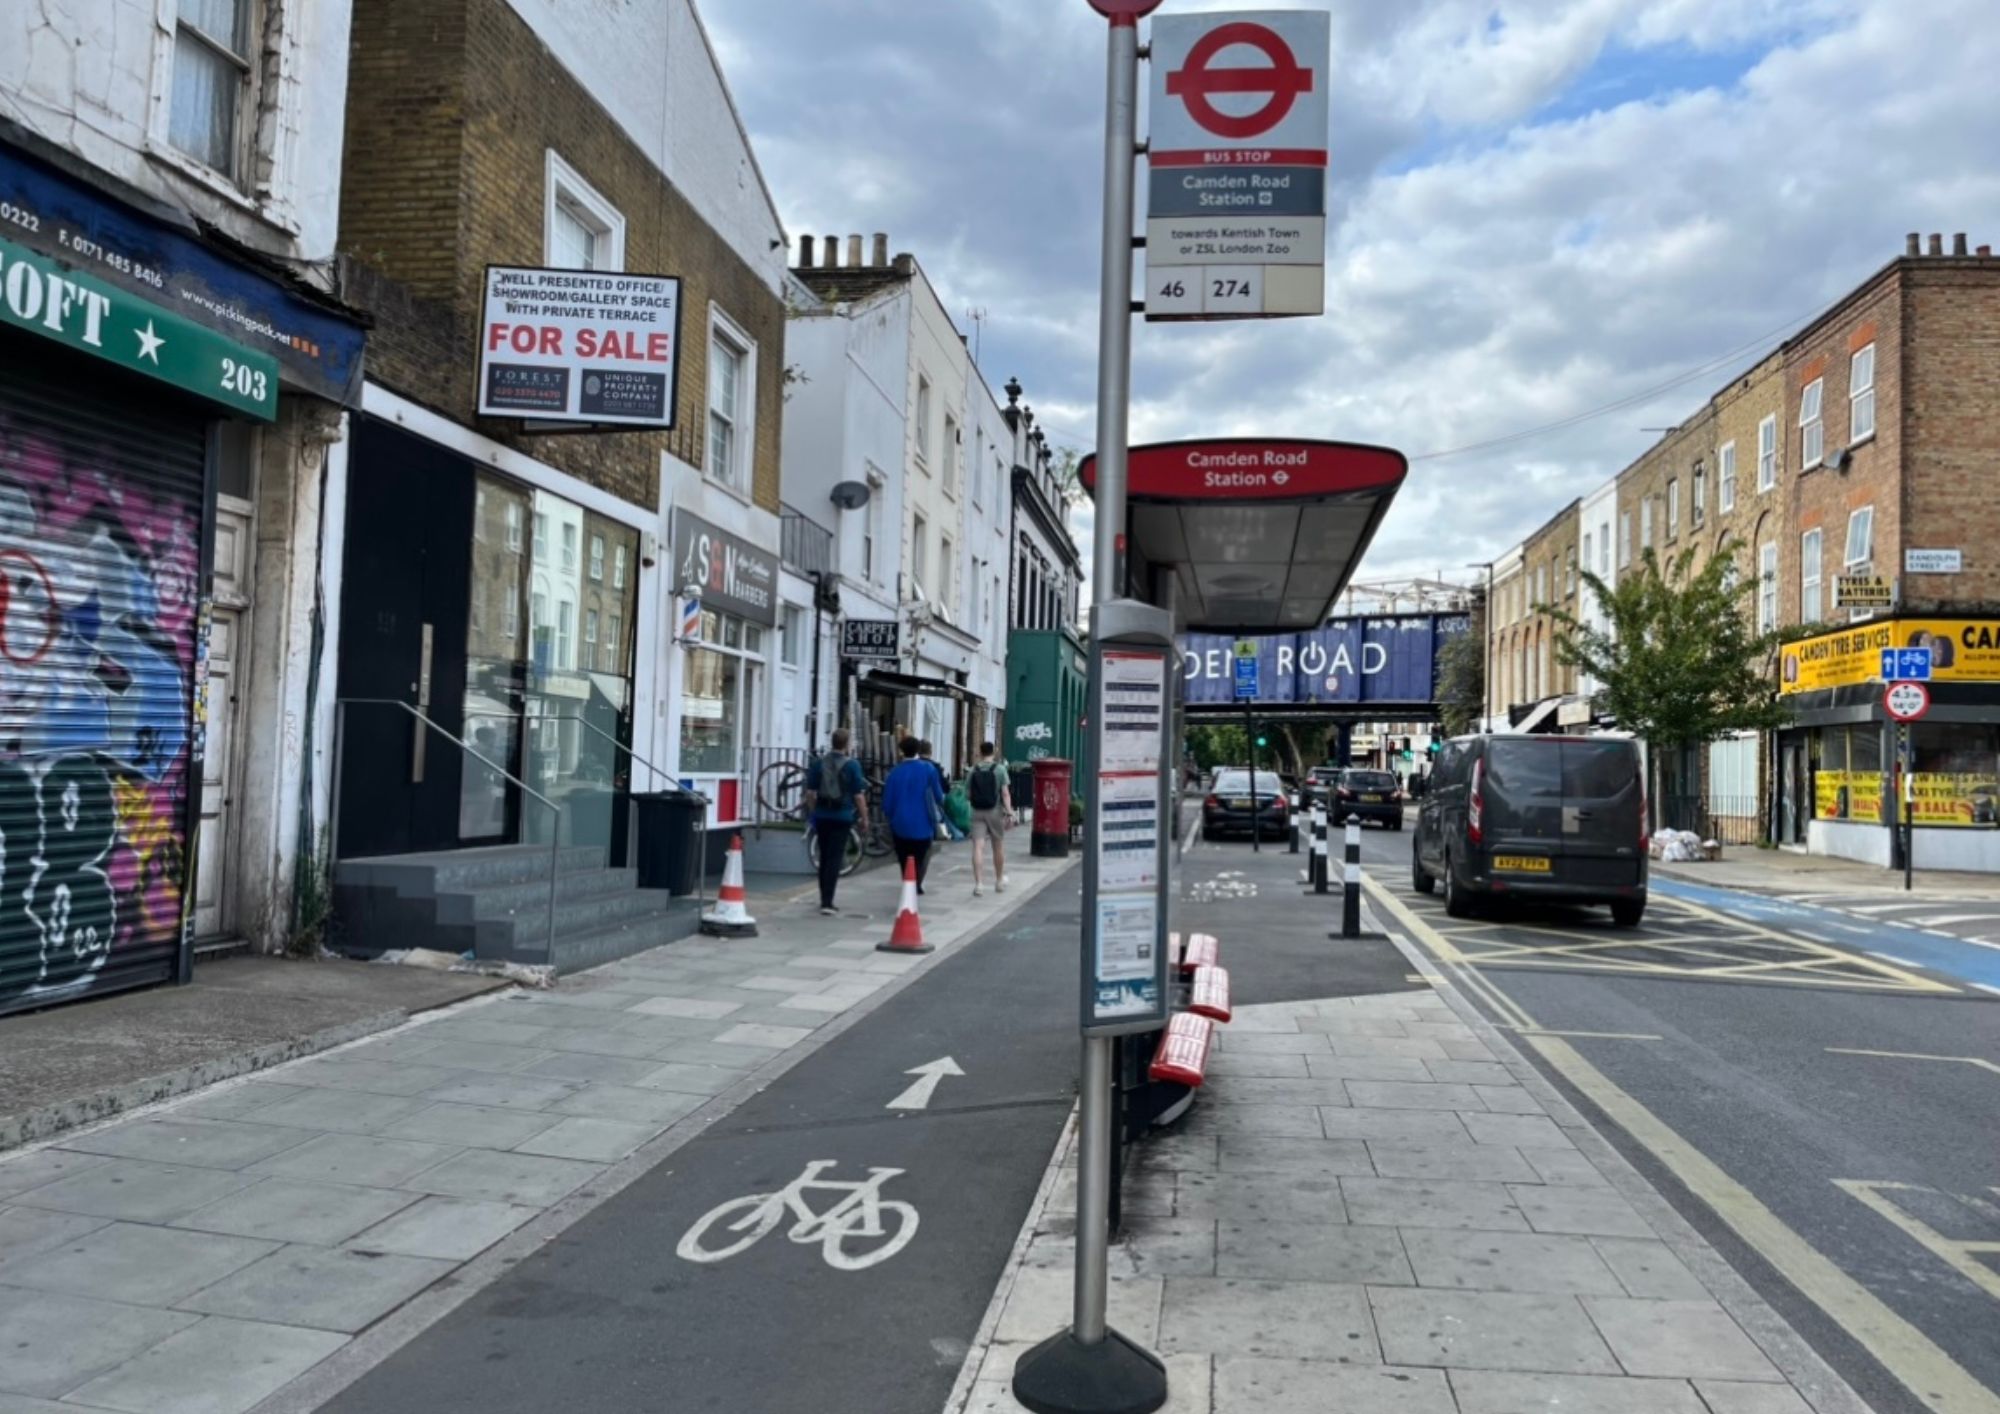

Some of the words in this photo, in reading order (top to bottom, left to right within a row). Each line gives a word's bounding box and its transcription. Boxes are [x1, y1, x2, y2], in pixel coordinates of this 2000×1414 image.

[1204, 151, 1230, 162] BUS
[1236, 150, 1271, 162] STOP
[1183, 175, 1247, 189] Camden
[1251, 174, 1290, 188] Road
[1199, 191, 1255, 206] Station
[1172, 229, 1218, 240] towards
[1221, 227, 1265, 238] Kentish
[1268, 227, 1300, 238] Town
[0, 202, 39, 233] 0222
[73, 236, 102, 260] 0171
[106, 252, 130, 273] 485
[134, 264, 163, 288] 8416
[1180, 246, 1193, 254] or
[1196, 244, 1216, 254] ZSL
[1219, 243, 1264, 254] London
[1267, 243, 1290, 254] Zoo
[500, 274, 535, 286] WELL
[539, 275, 613, 290] PRESENTED
[1160, 281, 1185, 297] 46
[1213, 280, 1250, 297] 274
[0, 251, 110, 347] OFT
[631, 297, 671, 308] SPACE
[505, 303, 539, 315] WITH
[542, 305, 595, 319] PRIVATE
[599, 308, 657, 322] TERRACE
[488, 322, 563, 355] FOR
[575, 328, 669, 362] SALE
[221, 358, 266, 401] 203
[495, 370, 563, 383] FOREST
[604, 374, 647, 383] UNIQUE
[604, 382, 658, 392] PROPERTY
[603, 391, 657, 401] COMPANY
[1187, 451, 1259, 468] Camden
[1263, 450, 1307, 466] Road
[1205, 471, 1266, 487] Station
[1838, 576, 1869, 586] TYRES
[1838, 586, 1890, 597] BATTERIES
[847, 633, 896, 646] SHOP
[1277, 641, 1387, 675] ROAD
